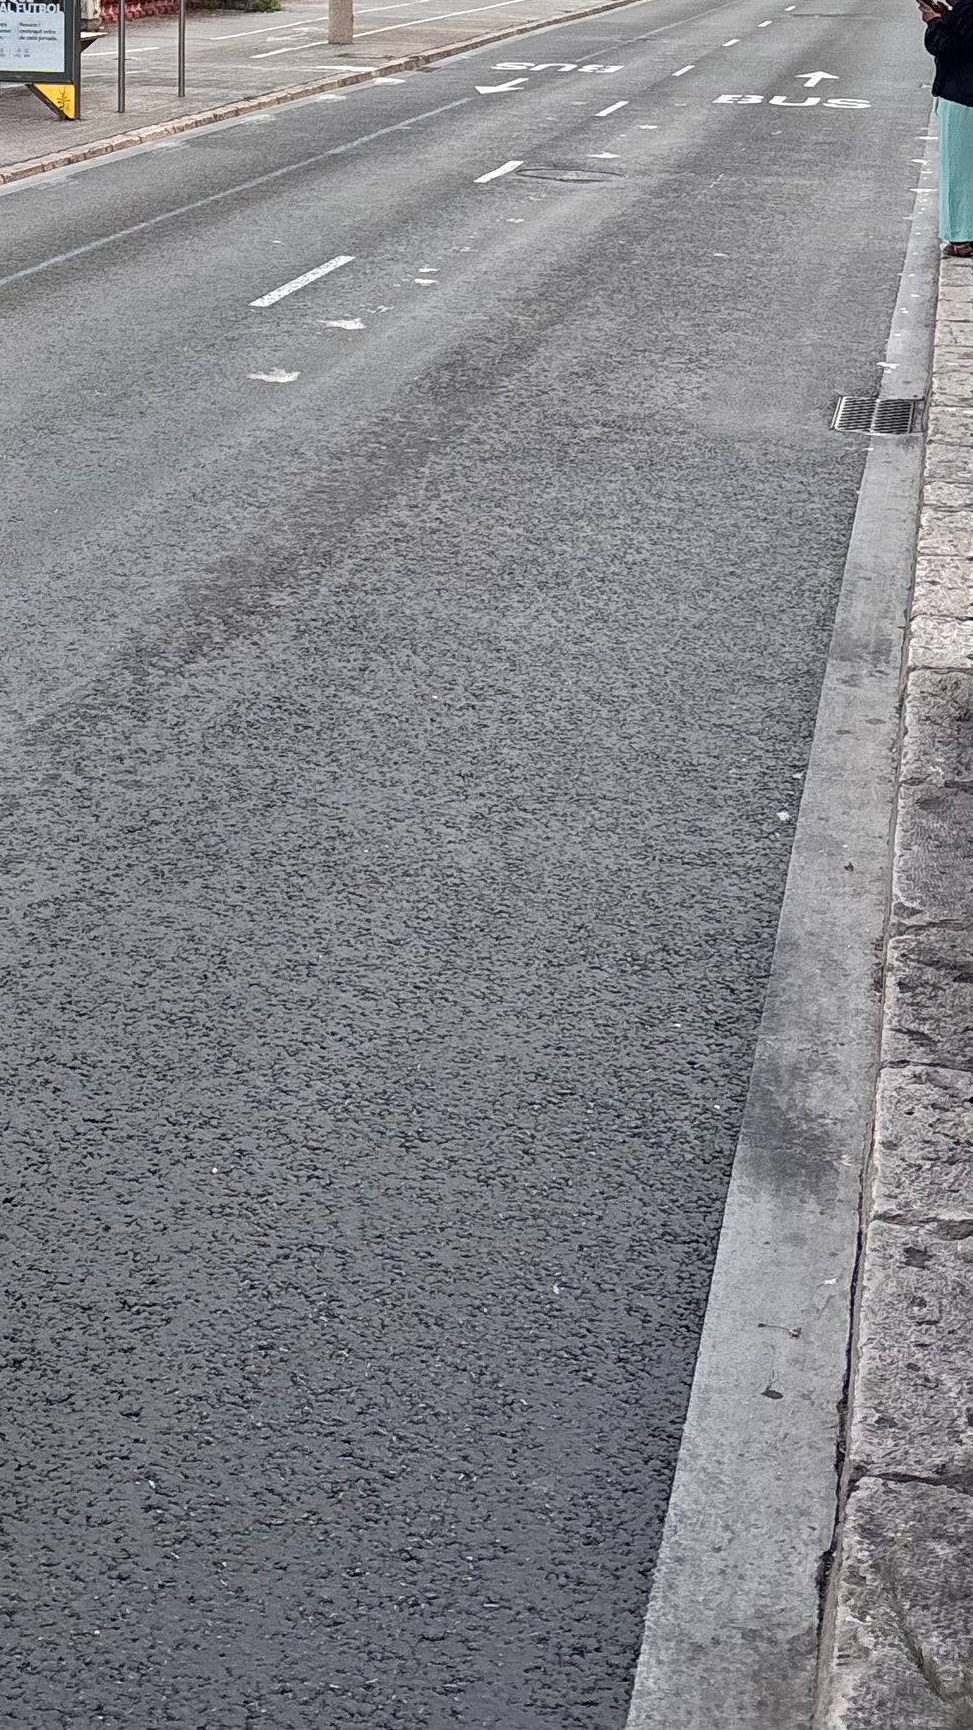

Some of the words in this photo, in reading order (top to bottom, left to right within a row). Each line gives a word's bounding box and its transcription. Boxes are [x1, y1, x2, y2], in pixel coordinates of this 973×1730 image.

[0, 3, 15, 13] AL
[15, 3, 60, 13] FUTBOL
[490, 62, 625, 74] BUS
[712, 94, 872, 109] BUS
